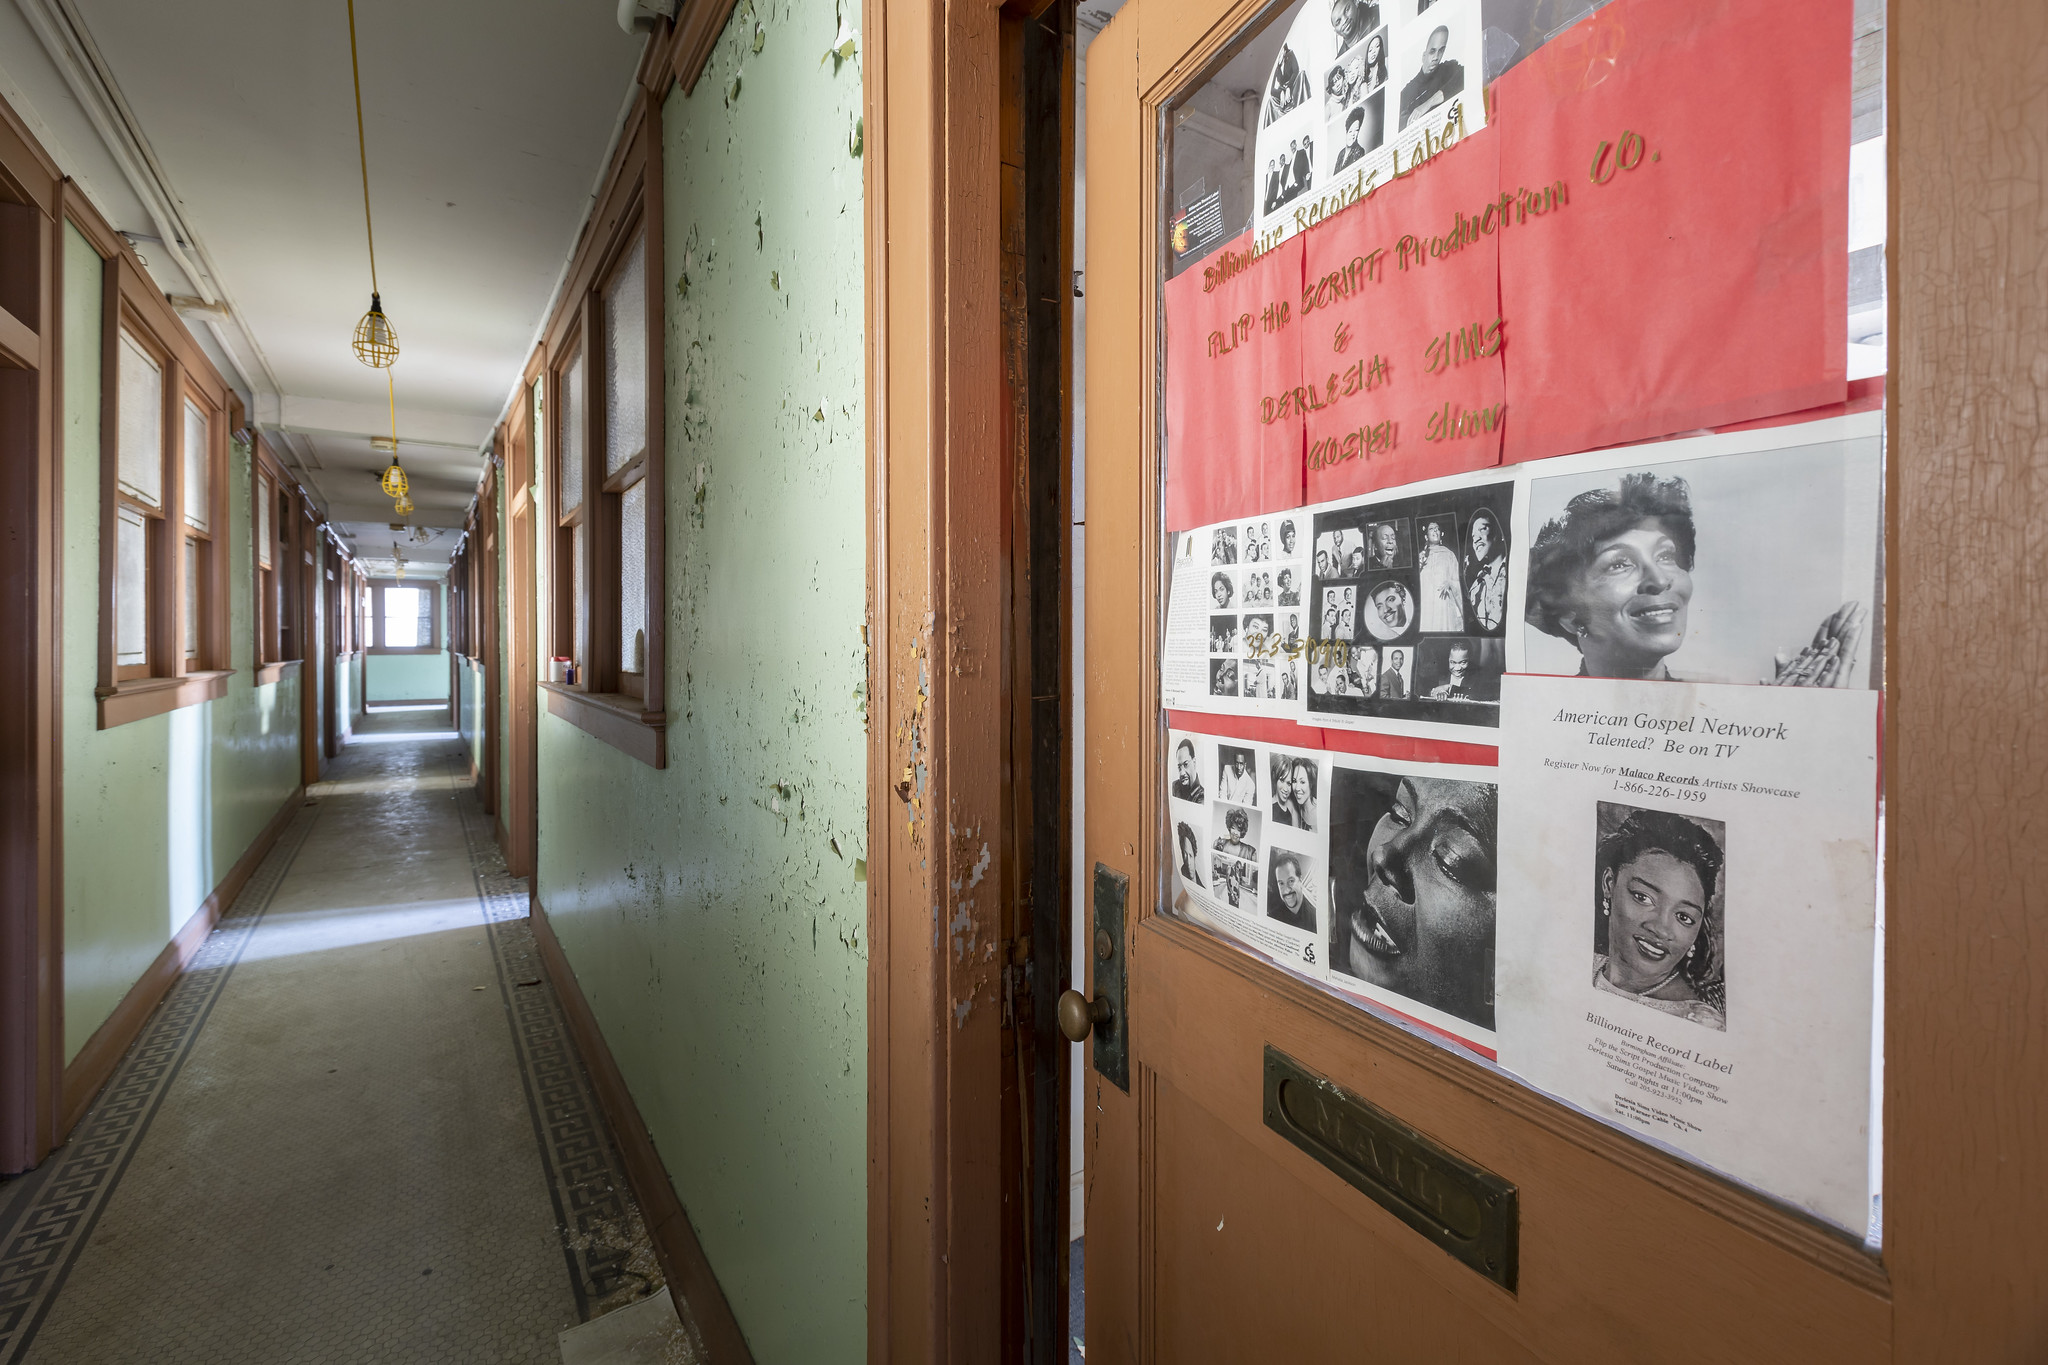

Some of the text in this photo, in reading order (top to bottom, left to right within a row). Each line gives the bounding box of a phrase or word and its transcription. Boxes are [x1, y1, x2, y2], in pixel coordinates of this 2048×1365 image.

[1293, 168, 1378, 234] Records
[1300, 247, 1384, 316] SCRIPT
[1396, 179, 1566, 272] Production
[1261, 318, 1503, 424] DERLESIA SIMS
[1553, 708, 1789, 740] American Gospel Network
[1588, 732, 1740, 759] Talented? Be on TV
[1544, 758, 1801, 799] Register Now for Malaco Records Artists Showcase
[1613, 780, 1707, 803] 1-866-226-1959
[1586, 1012, 1734, 1075] Billionaire Record Label
[1594, 1037, 1720, 1091] Flip the Script Production Company
[1621, 1040, 1657, 1059] Birmingham
[1587, 1044, 1729, 1105] Derlesia Sims Gospel Music Video Show
[1606, 1061, 1703, 1106] Saturday nights at 11:00pm
[1625, 1077, 1639, 1088] Call
[1614, 1100, 1629, 1110] Time
[1630, 1106, 1651, 1118] Warner
[1314, 1097, 1443, 1214] MAIL
